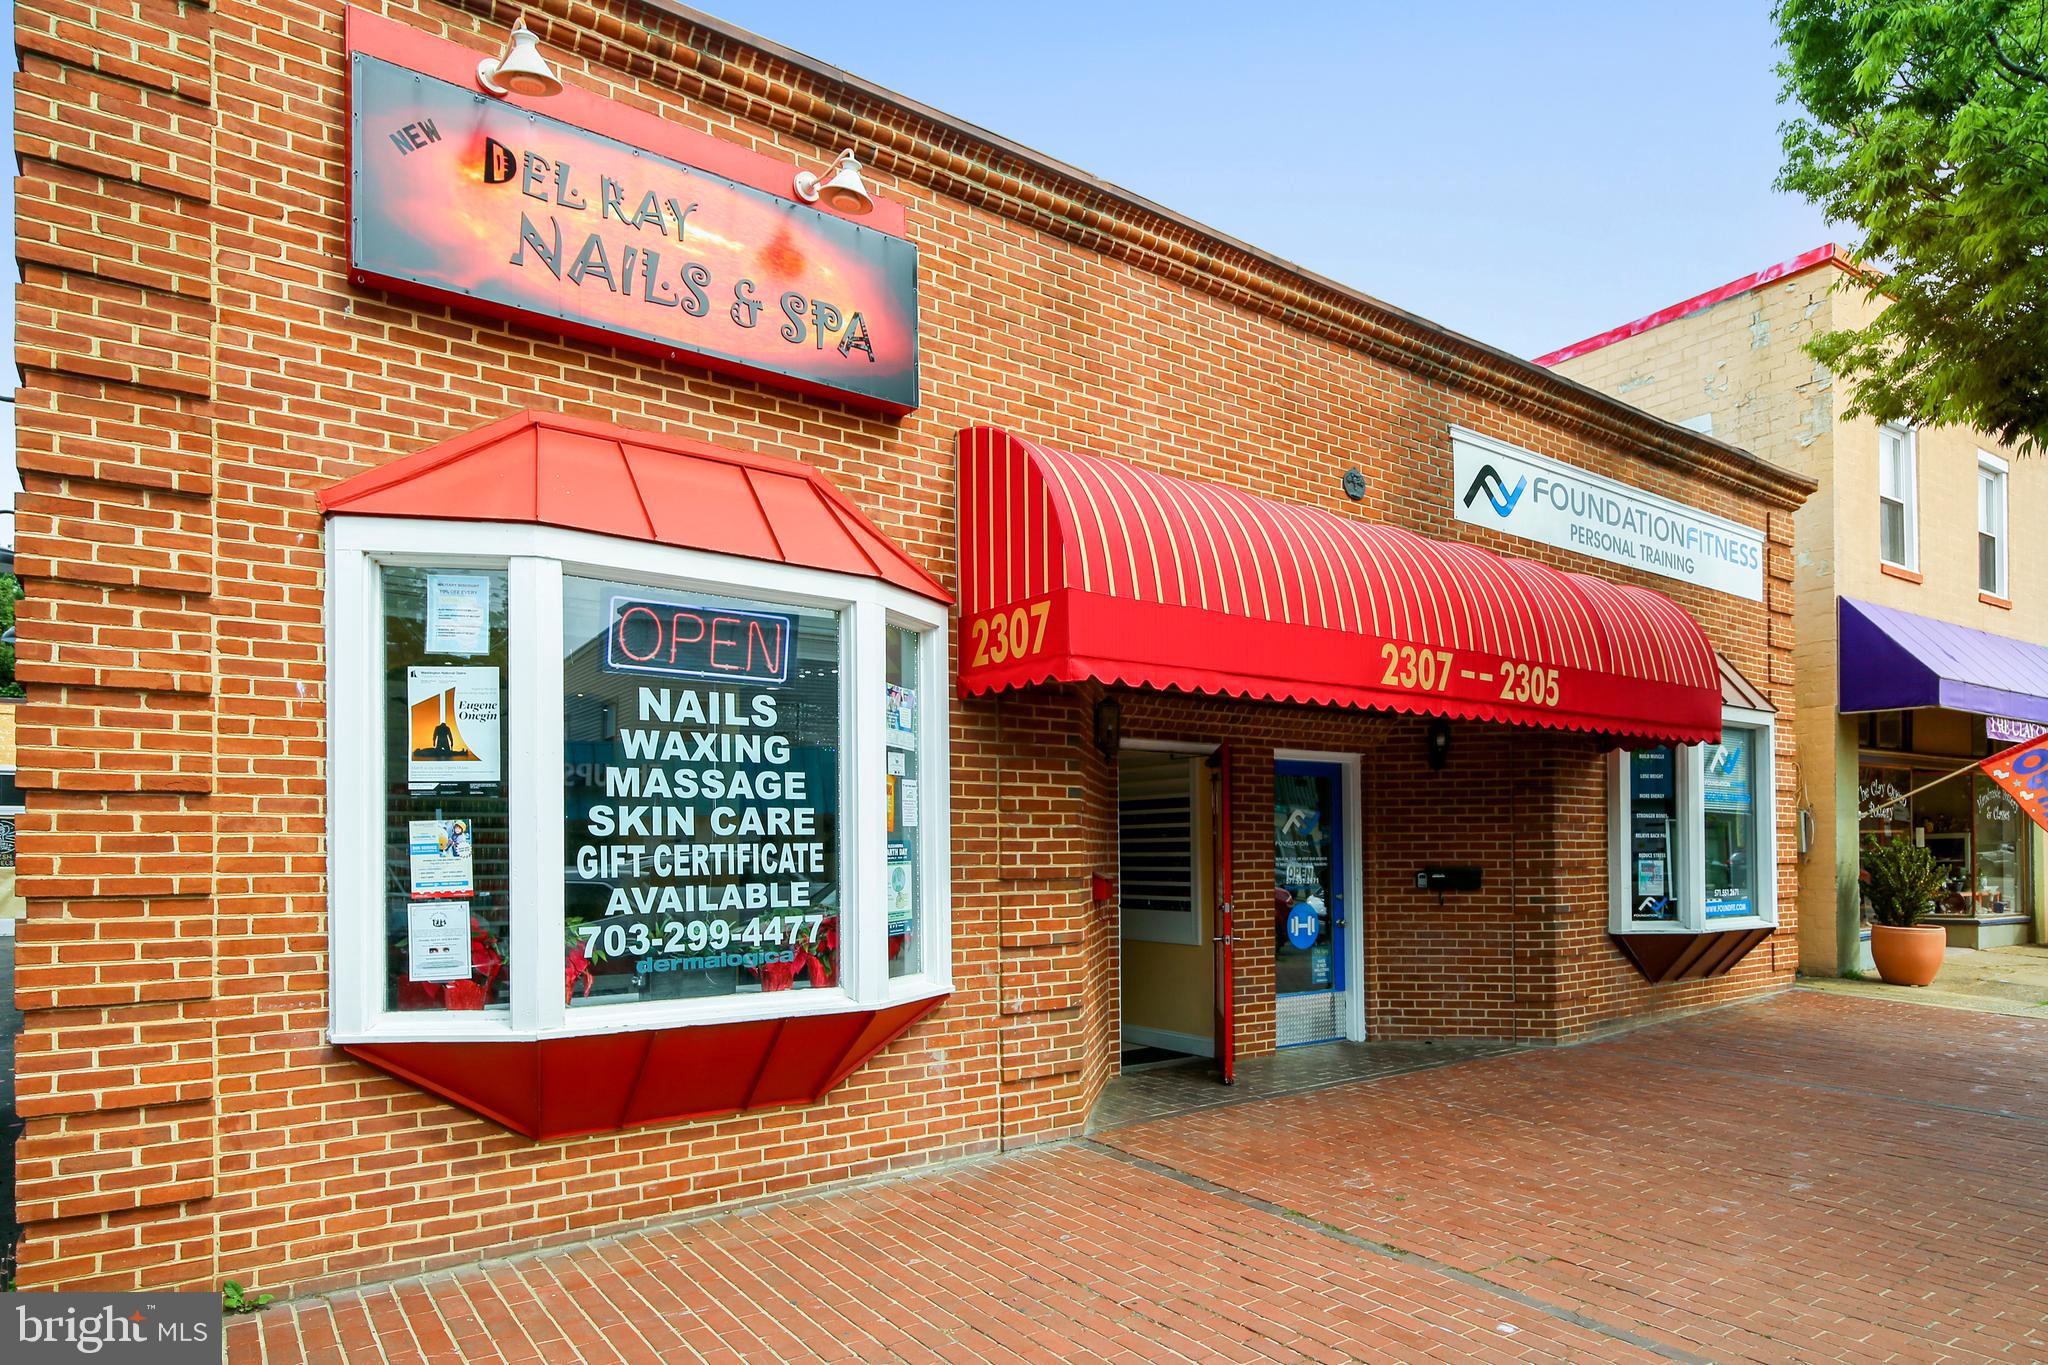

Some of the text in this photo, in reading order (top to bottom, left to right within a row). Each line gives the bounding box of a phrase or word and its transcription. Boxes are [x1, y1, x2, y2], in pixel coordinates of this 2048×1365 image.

[388, 118, 442, 156] NEW
[484, 136, 698, 242] DEL RAY
[509, 211, 875, 363] NAILS & SPA
[1570, 523, 1695, 575] PERSONAL TRAINING
[619, 606, 781, 674] OPEN
[971, 600, 1051, 668] 2307
[1380, 643, 1454, 692] 2307
[1499, 661, 1560, 707] 2305
[458, 700, 498, 713] Eugene
[458, 711, 498, 723] Onegin
[638, 686, 778, 728] NAILS
[620, 728, 791, 765] WAXING
[605, 766, 808, 800] MASSAGE
[587, 805, 816, 837] SKIN CARE
[576, 842, 825, 880] GIFT CERTIFICATE
[604, 882, 811, 916] AVAILABLE
[578, 915, 823, 959] 703-299-4477
[636, 950, 795, 974] dermalogica
